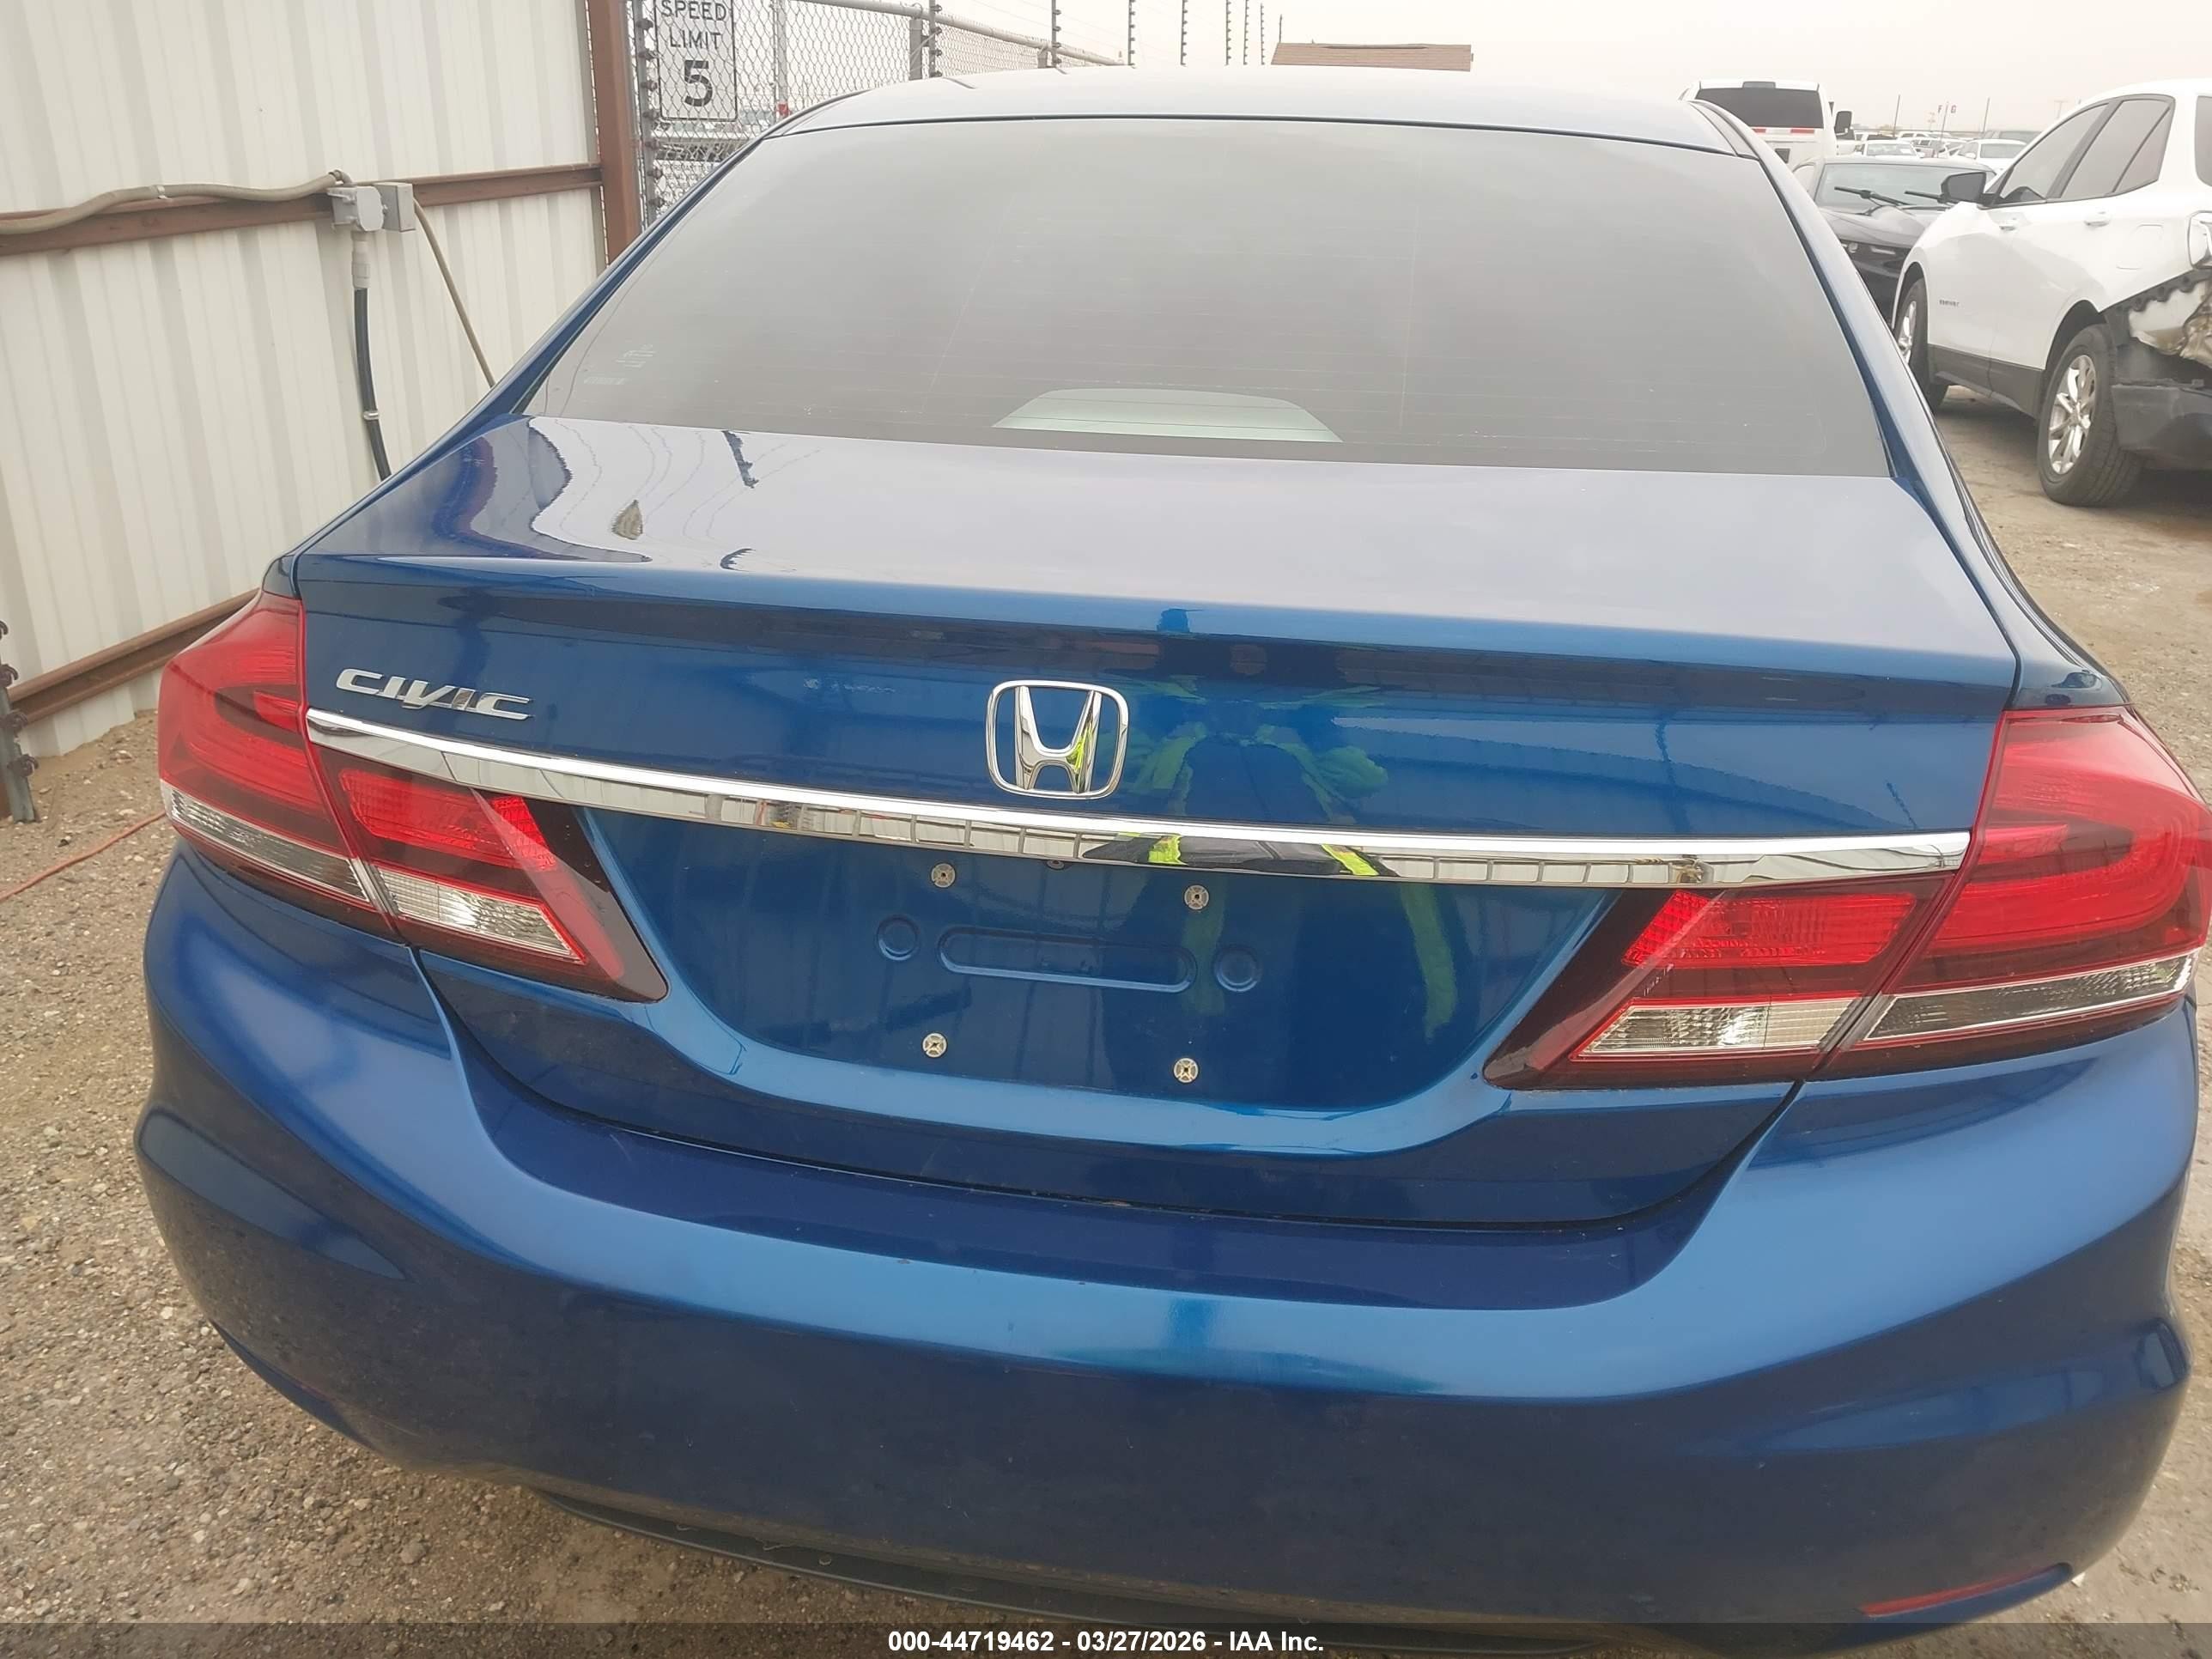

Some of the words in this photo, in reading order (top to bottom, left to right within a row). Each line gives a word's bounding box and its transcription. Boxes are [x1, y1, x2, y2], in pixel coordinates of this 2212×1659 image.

[661, 0, 727, 21] SPEED
[669, 30, 722, 49] LIMIT
[684, 59, 714, 106] 5
[336, 668, 531, 720] CIVIC
